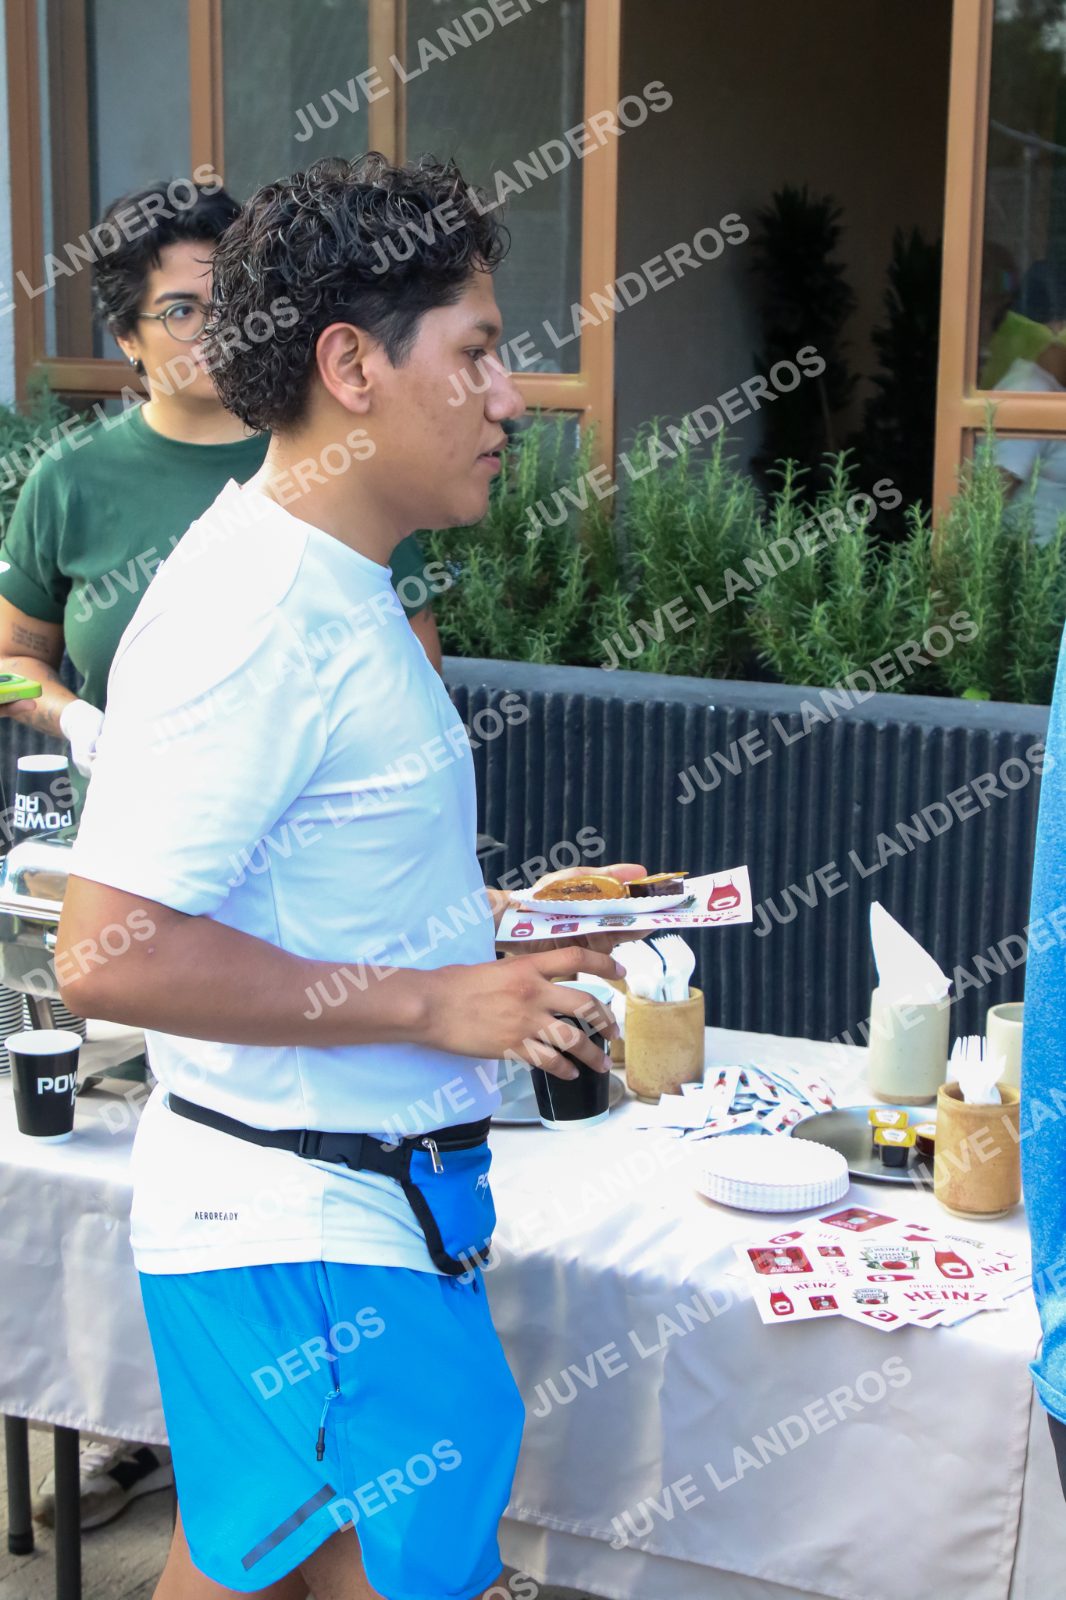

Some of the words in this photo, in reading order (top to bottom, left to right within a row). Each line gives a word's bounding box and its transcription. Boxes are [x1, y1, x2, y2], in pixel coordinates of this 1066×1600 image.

[652, 914, 742, 924] HEINZ
[194, 1211, 239, 1221] AEROREADY
[903, 1290, 988, 1302] HEINZ
